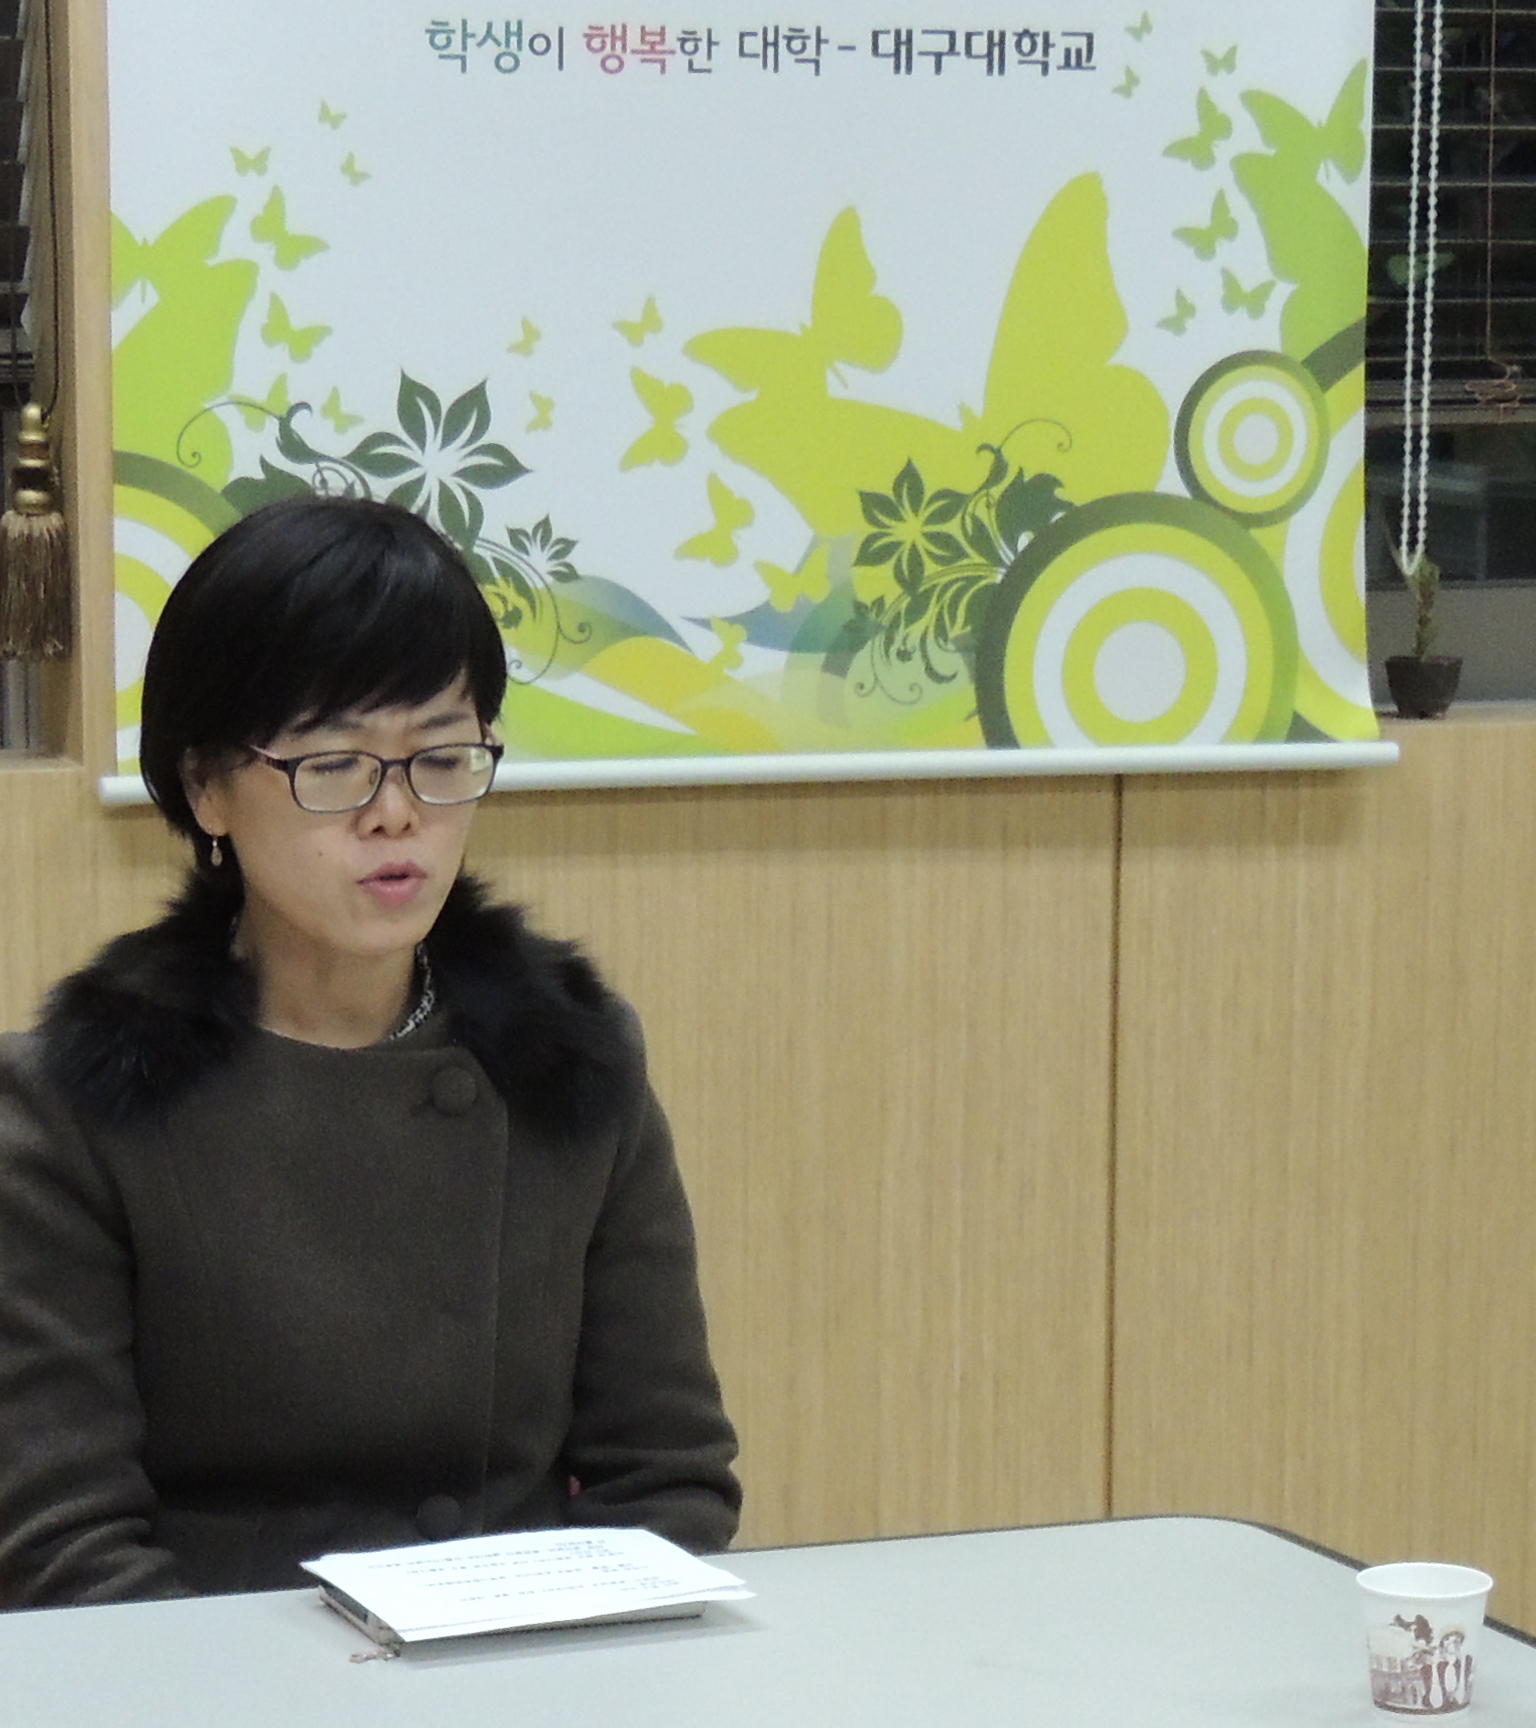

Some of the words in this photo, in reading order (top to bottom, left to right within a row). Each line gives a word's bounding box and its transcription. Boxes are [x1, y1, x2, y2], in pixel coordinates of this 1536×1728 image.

[425, 19, 565, 76] 학생이
[582, 20, 720, 76] 행복한
[870, 25, 1097, 77] 대구대학교
